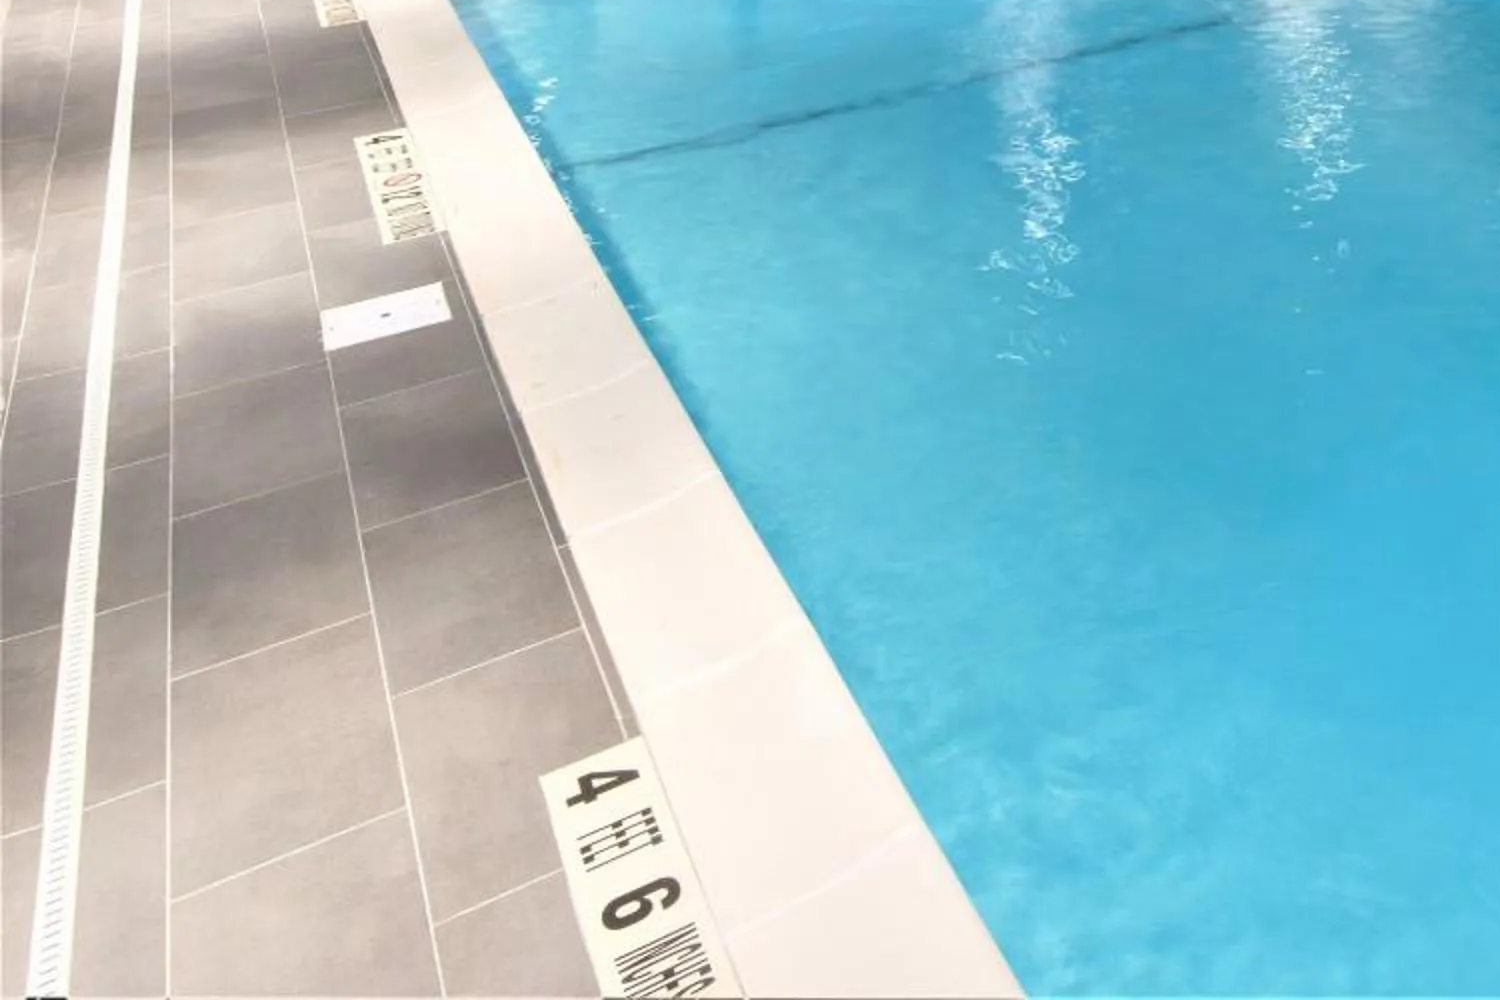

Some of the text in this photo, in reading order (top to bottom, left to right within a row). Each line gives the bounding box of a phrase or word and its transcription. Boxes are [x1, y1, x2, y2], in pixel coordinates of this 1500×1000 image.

[565, 769, 641, 808] 4
[576, 806, 665, 873] FEET
[601, 876, 681, 931] 6
